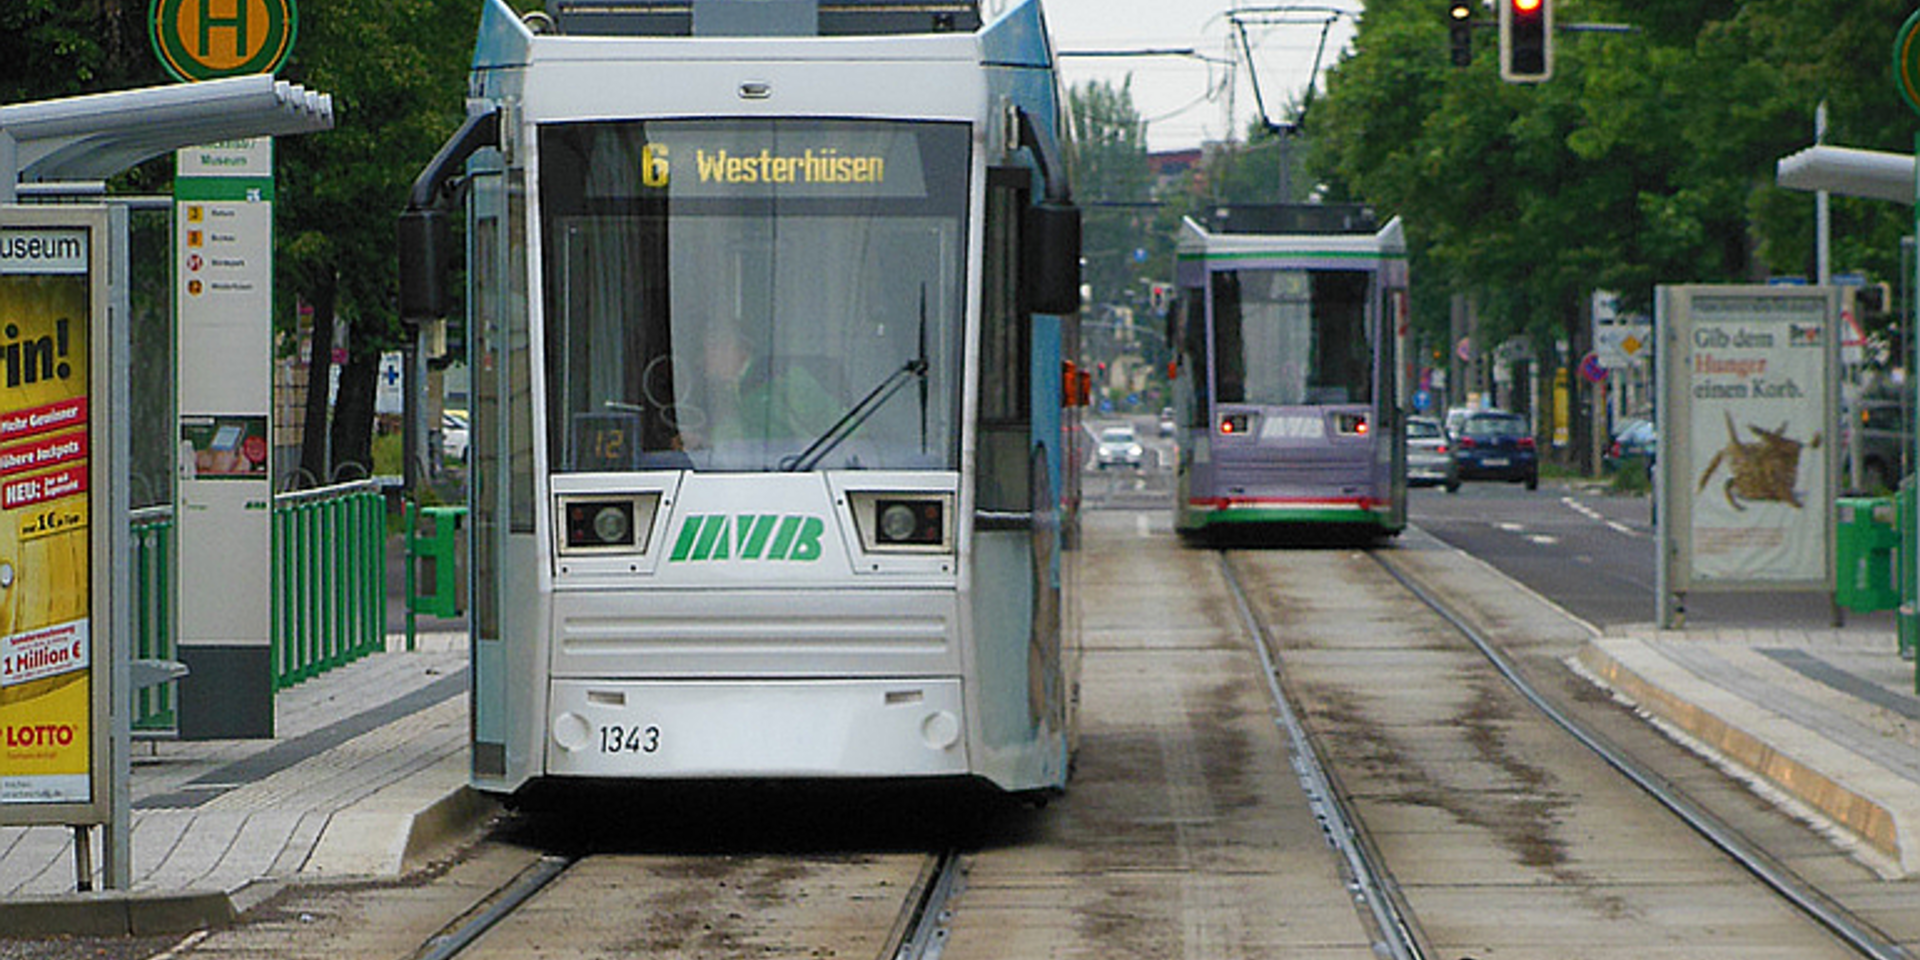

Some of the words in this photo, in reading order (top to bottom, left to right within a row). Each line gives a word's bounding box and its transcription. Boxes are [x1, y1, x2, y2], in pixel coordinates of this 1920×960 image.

[642, 142, 669, 187] 6
[697, 147, 884, 183] Westerhüsen
[1695, 327, 1731, 348] Gib
[1733, 327, 1774, 348] dem
[1695, 353, 1767, 378] Hunger
[1693, 378, 1749, 398] einen
[595, 429, 624, 459] 12
[6, 479, 41, 505] NEU:
[4, 656, 14, 675] 1
[17, 645, 69, 673] Million
[72, 639, 81, 659] €
[7, 724, 74, 747] LOTTO
[600, 726, 660, 753] 1343
